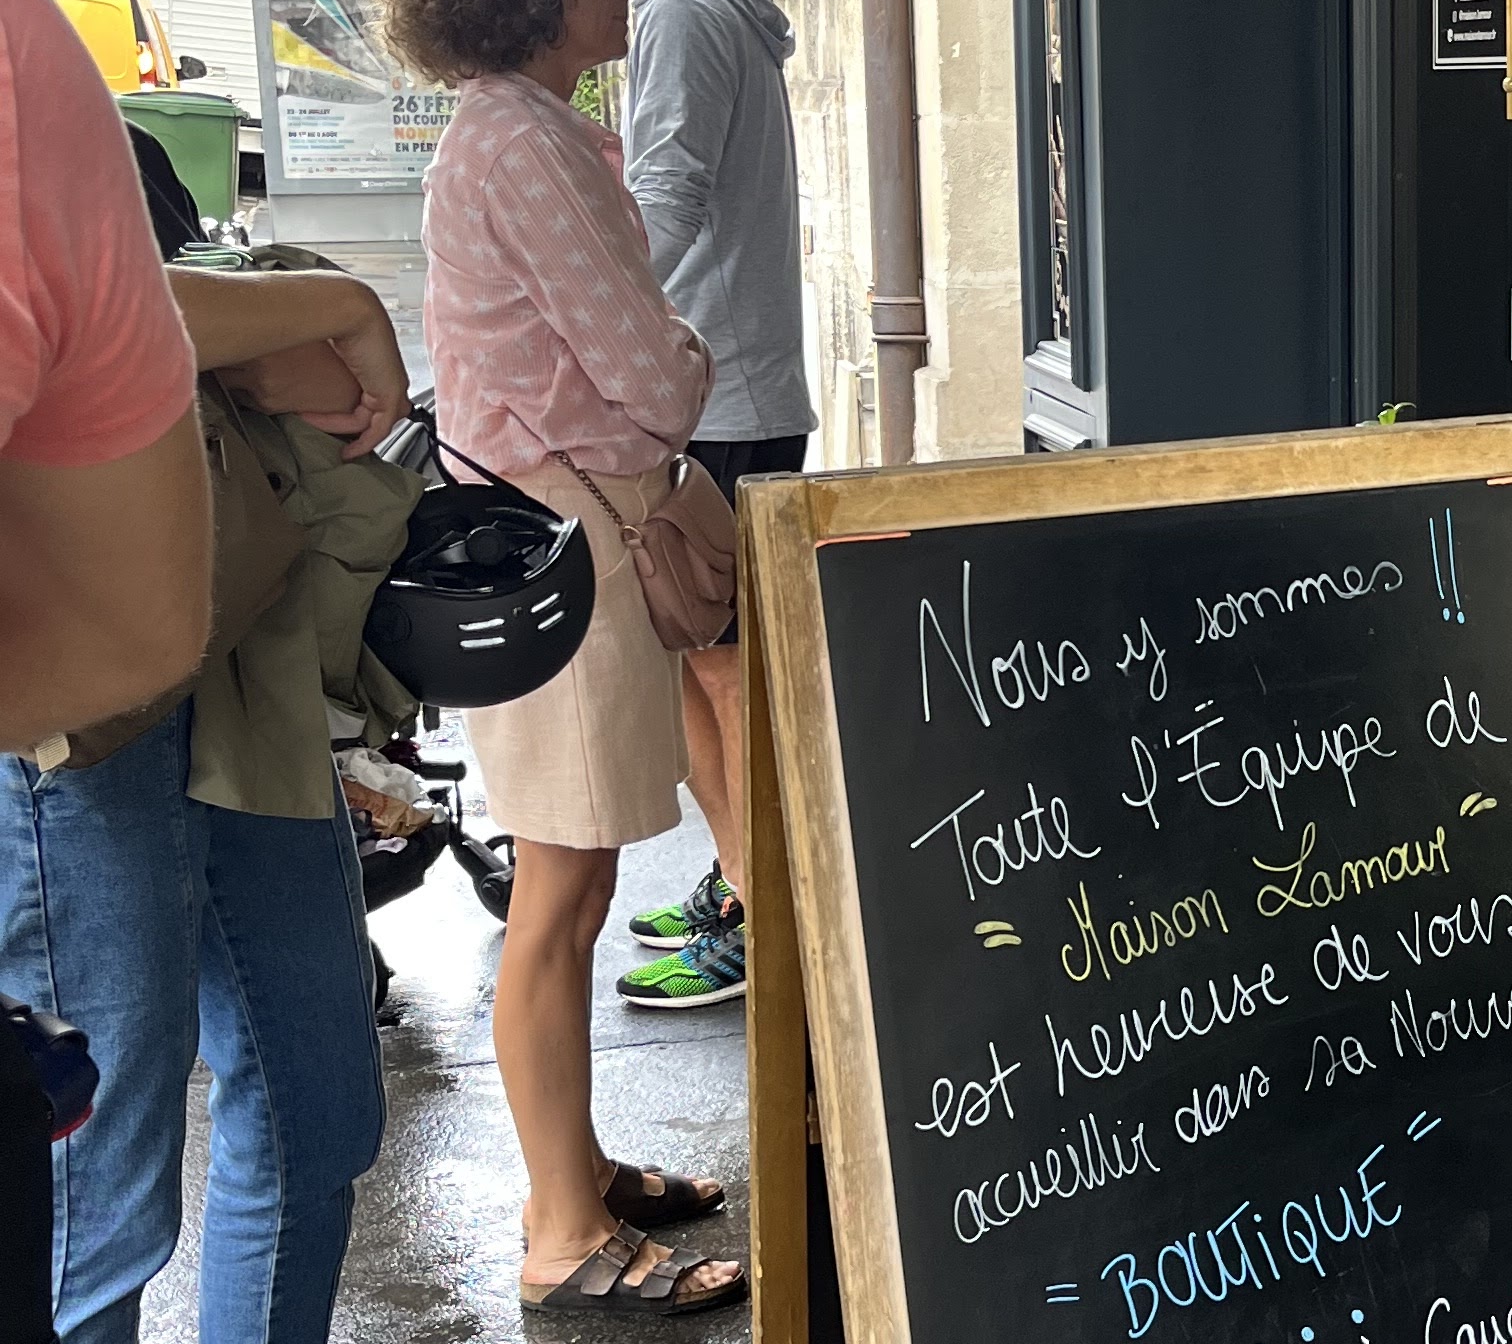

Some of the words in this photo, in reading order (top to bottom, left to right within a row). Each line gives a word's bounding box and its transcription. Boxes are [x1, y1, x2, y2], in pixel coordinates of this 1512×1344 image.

[393, 115, 410, 125] DU
[395, 143, 409, 152] EN
[921, 560, 1090, 727] Nous
[1116, 617, 1166, 701] y
[1196, 561, 1404, 644] sommes
[910, 783, 1101, 901] Toute
[1427, 676, 1508, 749] de
[1061, 873, 1229, 982] Maison
[1253, 822, 1450, 917] Lamour
[915, 1042, 1022, 1137] est
[1046, 962, 1290, 1096] heureuse
[1313, 925, 1390, 990] de
[952, 1113, 1160, 1244] accueillir
[1175, 1064, 1271, 1144] dans
[1305, 1035, 1376, 1092] sa
